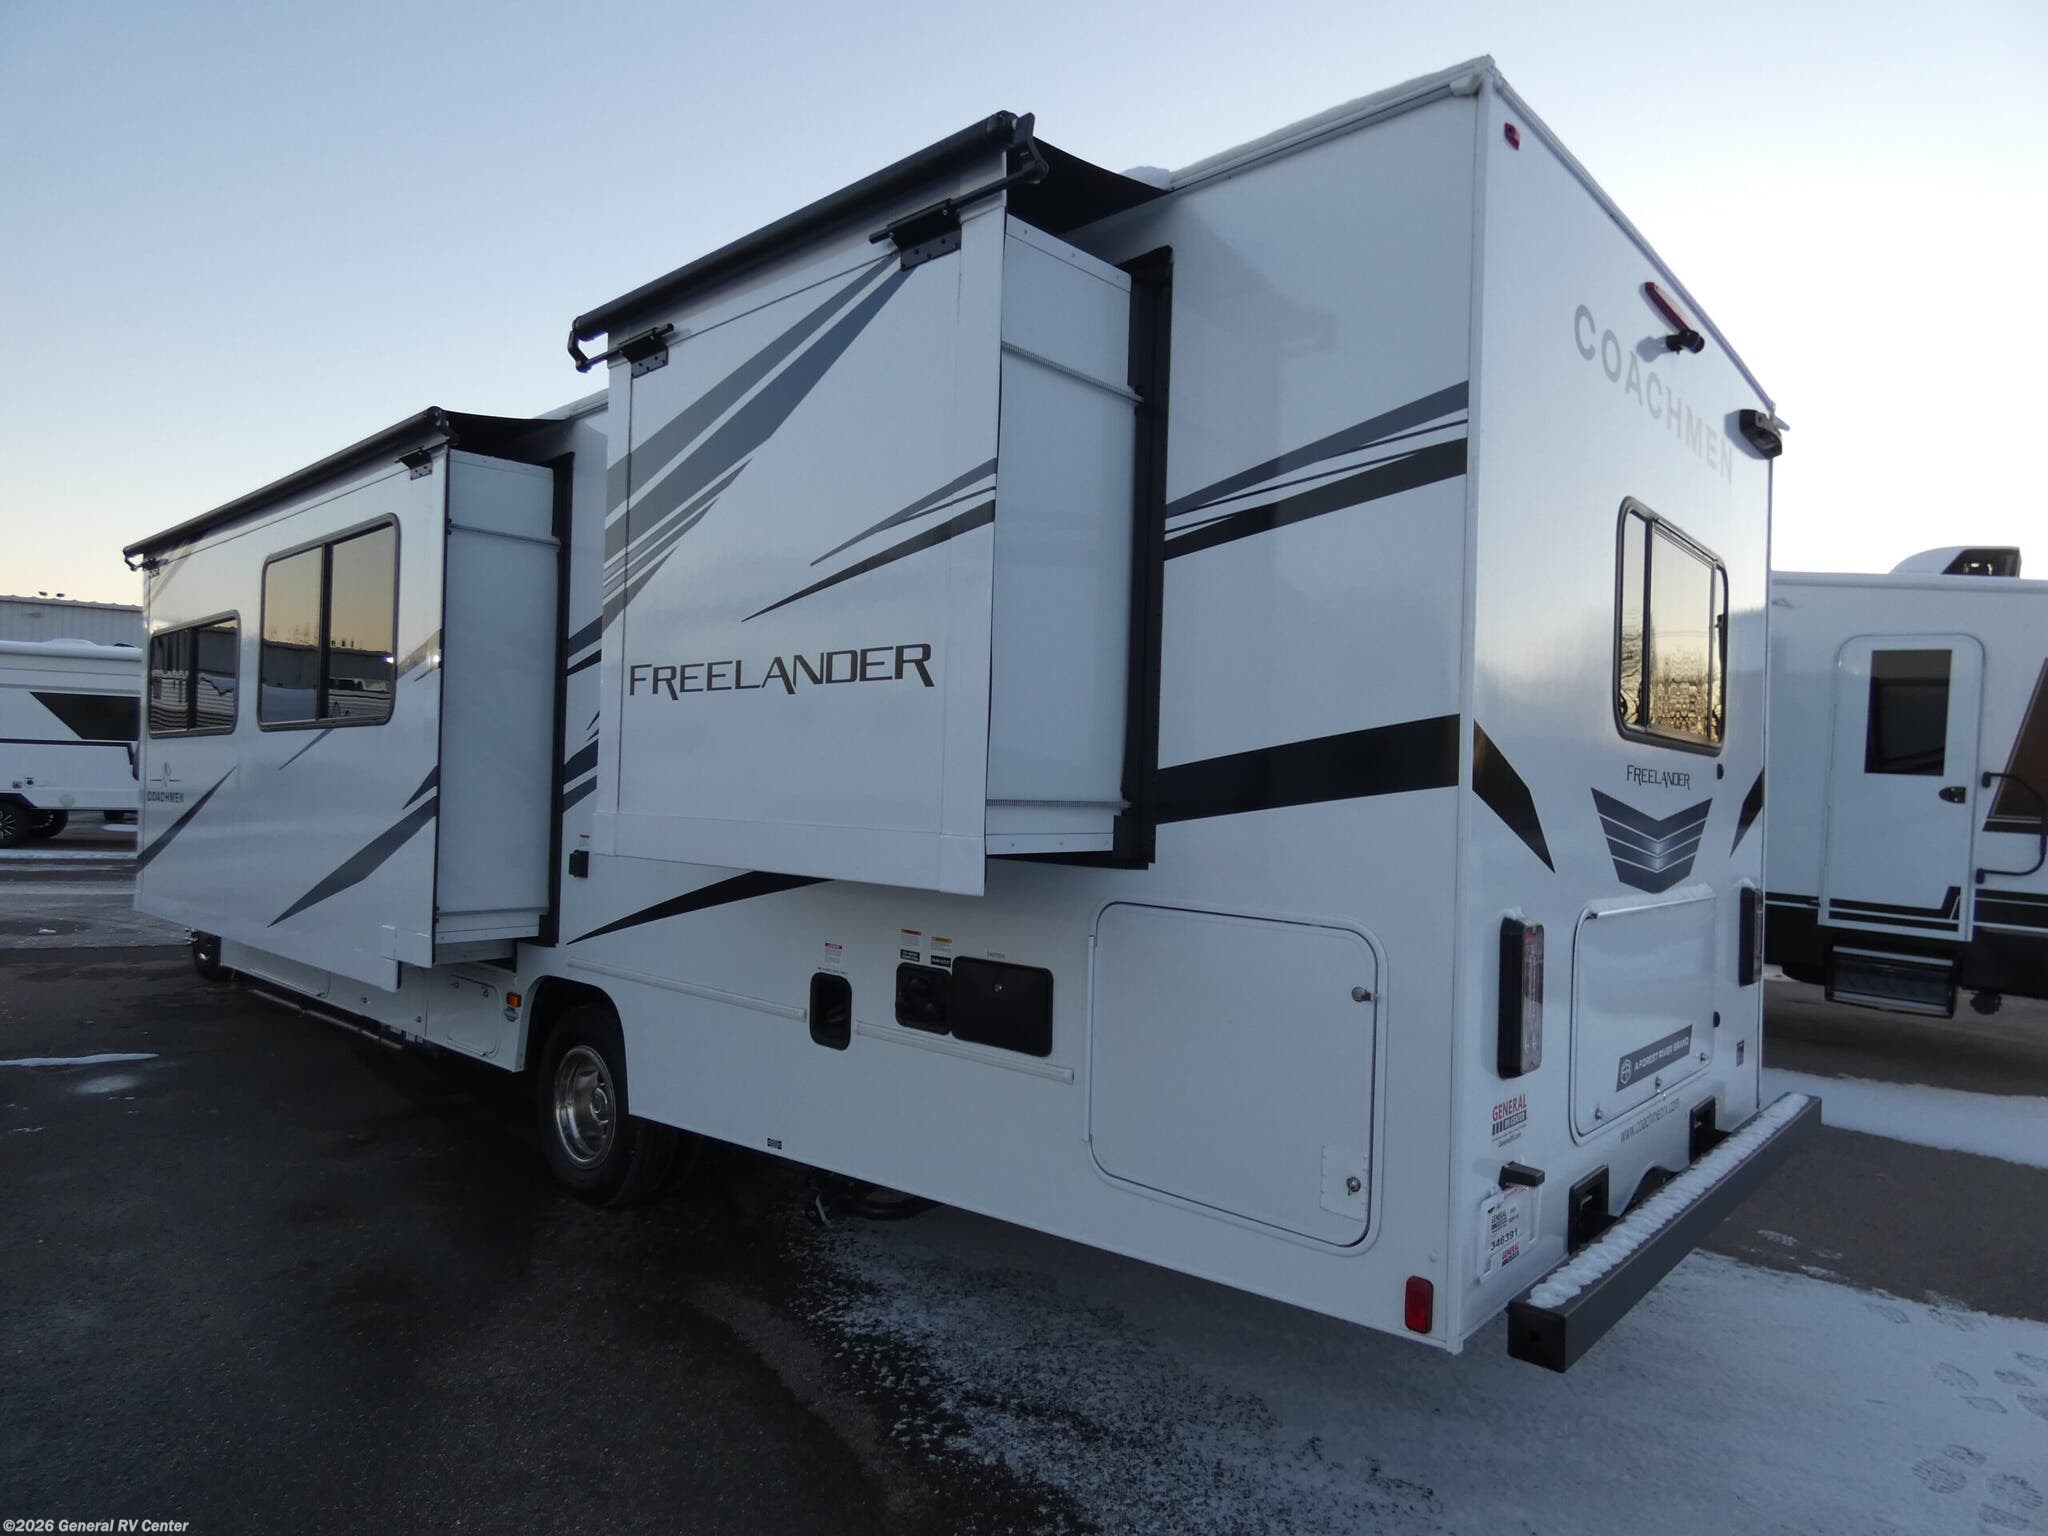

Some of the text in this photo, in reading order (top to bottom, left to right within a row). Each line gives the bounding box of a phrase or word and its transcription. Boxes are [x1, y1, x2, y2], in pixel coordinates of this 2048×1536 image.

[1574, 303, 1733, 484] COACHMEN
[629, 643, 934, 701] FREELANDER
[1626, 764, 1690, 790] FREELANDER
[147, 791, 184, 803] COACHMEN
[1492, 1093, 1527, 1122] GENERAL
